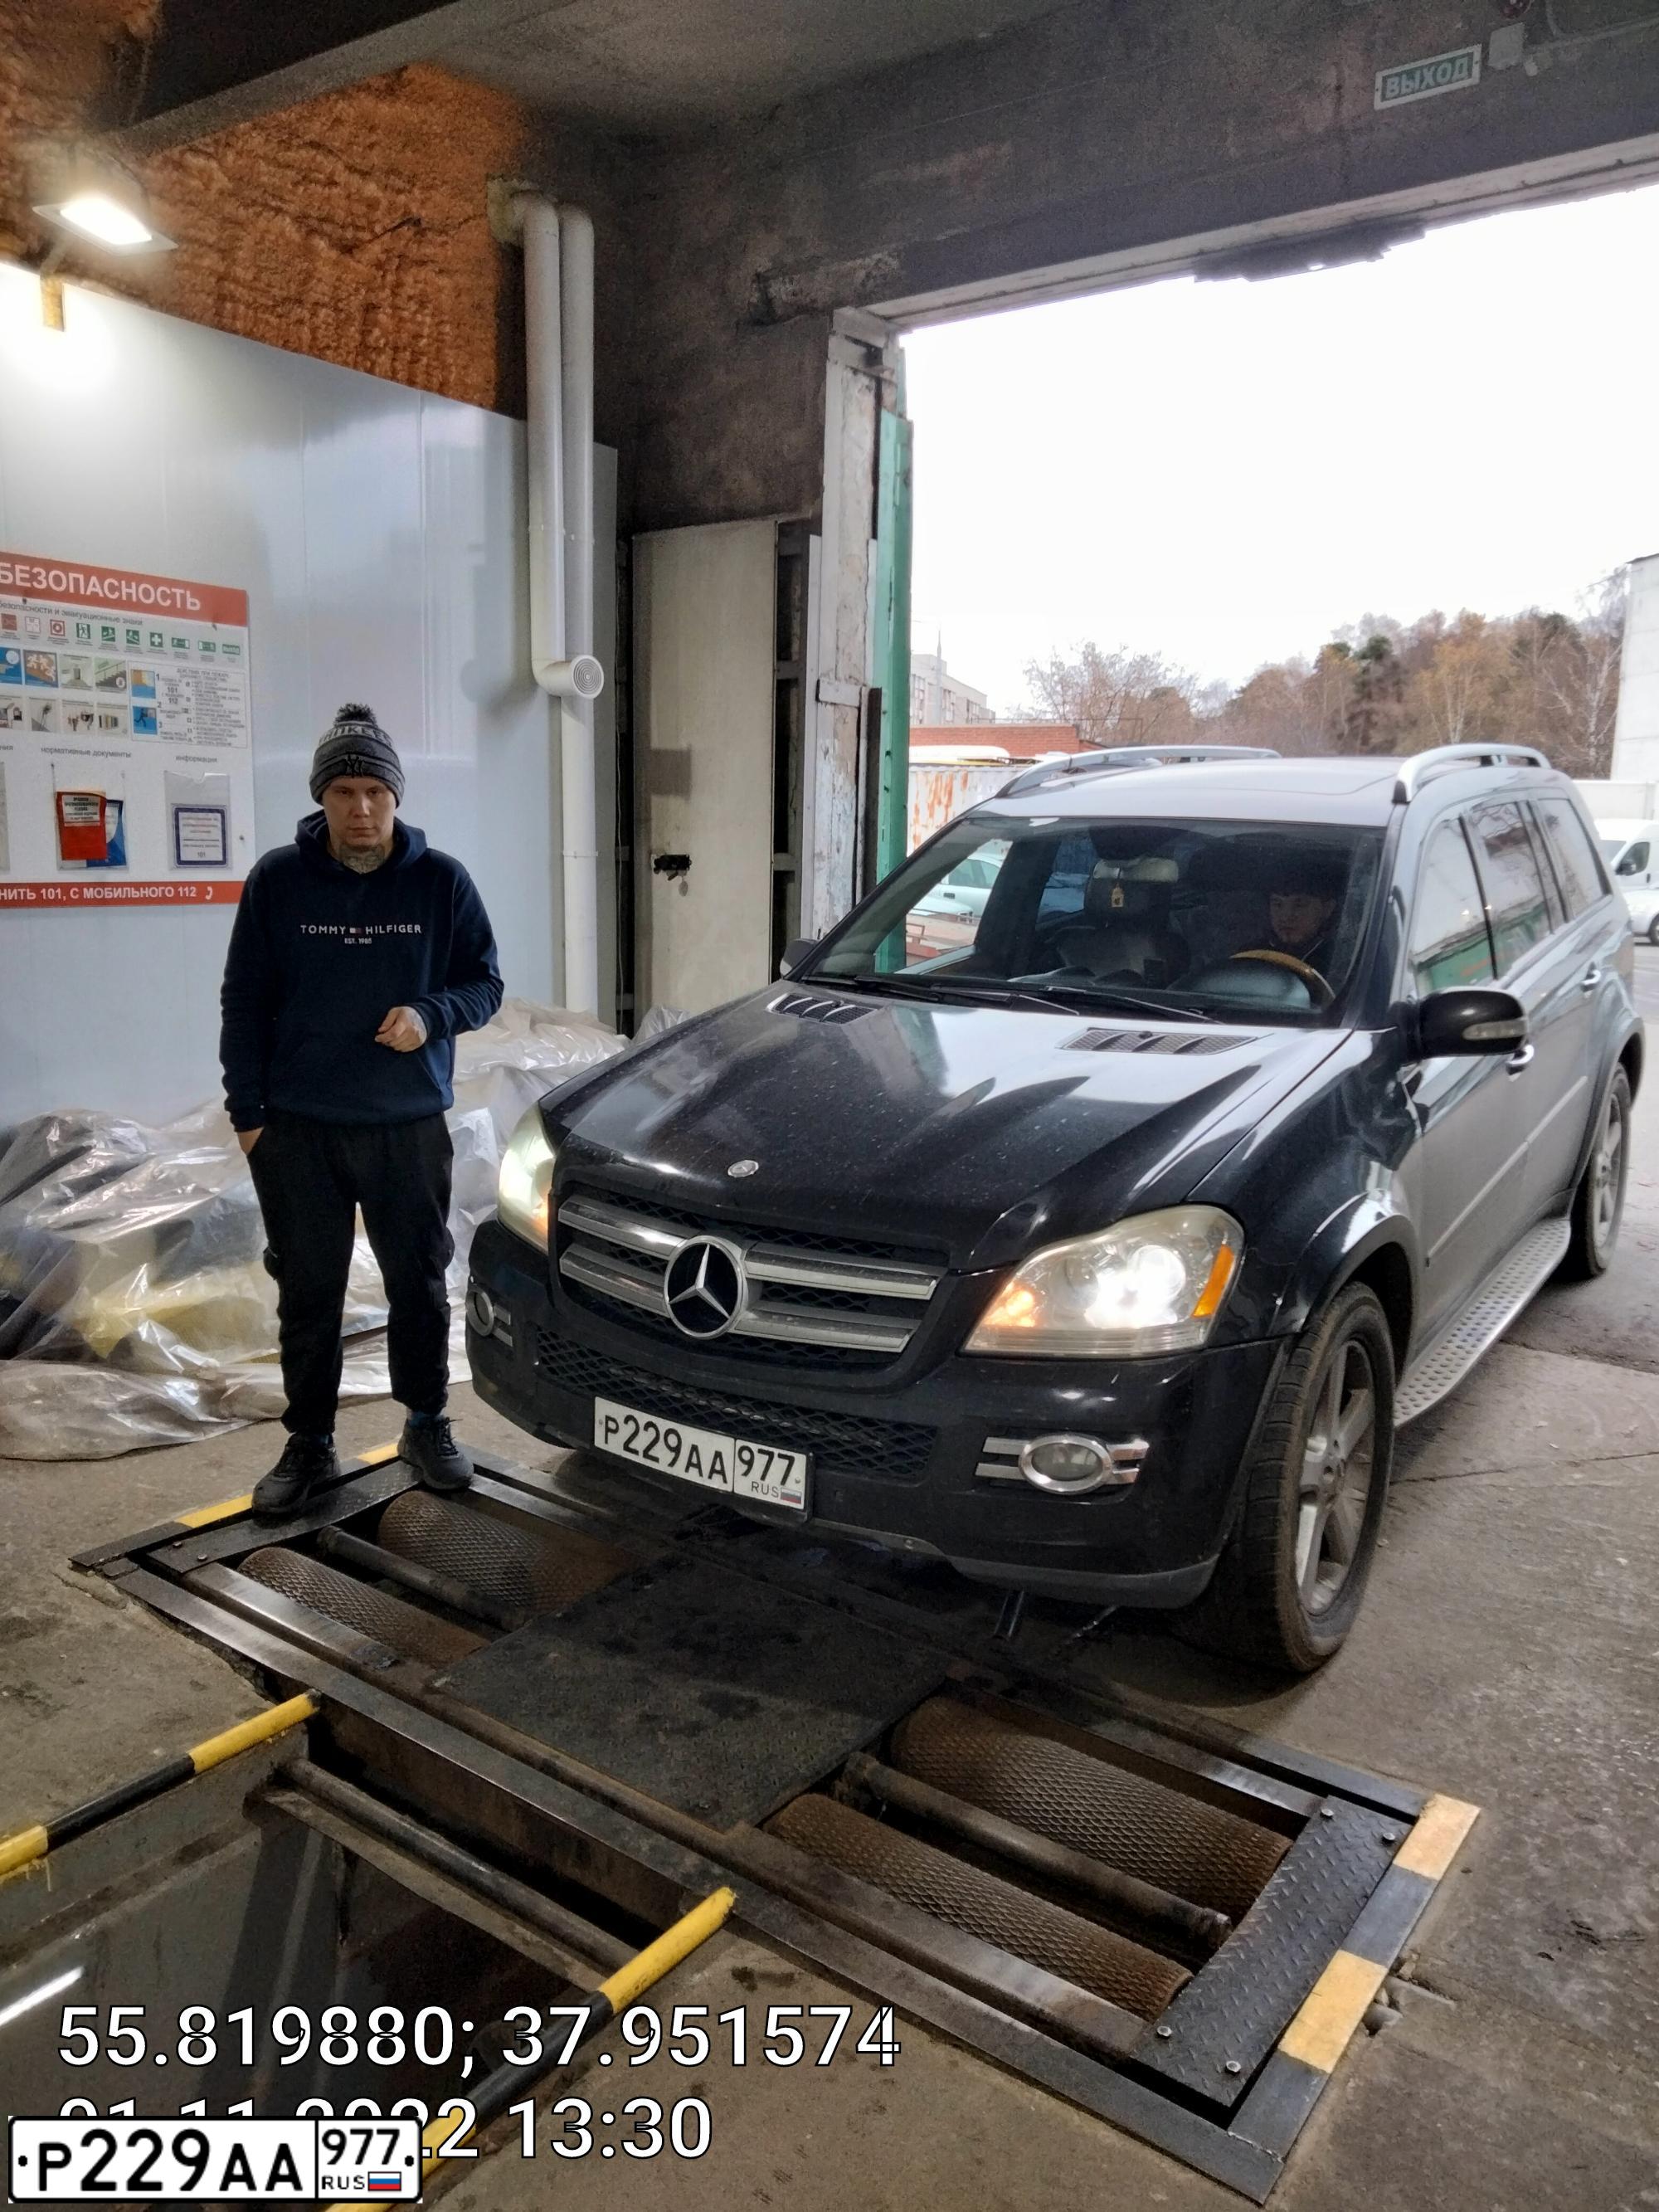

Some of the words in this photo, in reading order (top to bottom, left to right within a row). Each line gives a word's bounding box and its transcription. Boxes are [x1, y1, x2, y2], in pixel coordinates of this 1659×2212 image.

[1386, 58, 1469, 98] ВЫХОД
[0, 562, 201, 611] БЕЗОПАСНОСТЬ
[41, 888, 66, 901] 101,
[70, 887, 79, 899] С
[83, 885, 174, 899] МОБИЛЬНОГО
[178, 886, 197, 897] 112
[300, 925, 346, 934] TOMMY
[365, 924, 421, 934] HILFIGER
[604, 1414, 728, 1484] Р229АА
[737, 1445, 796, 1486] 977
[751, 1481, 780, 1498] RUS
